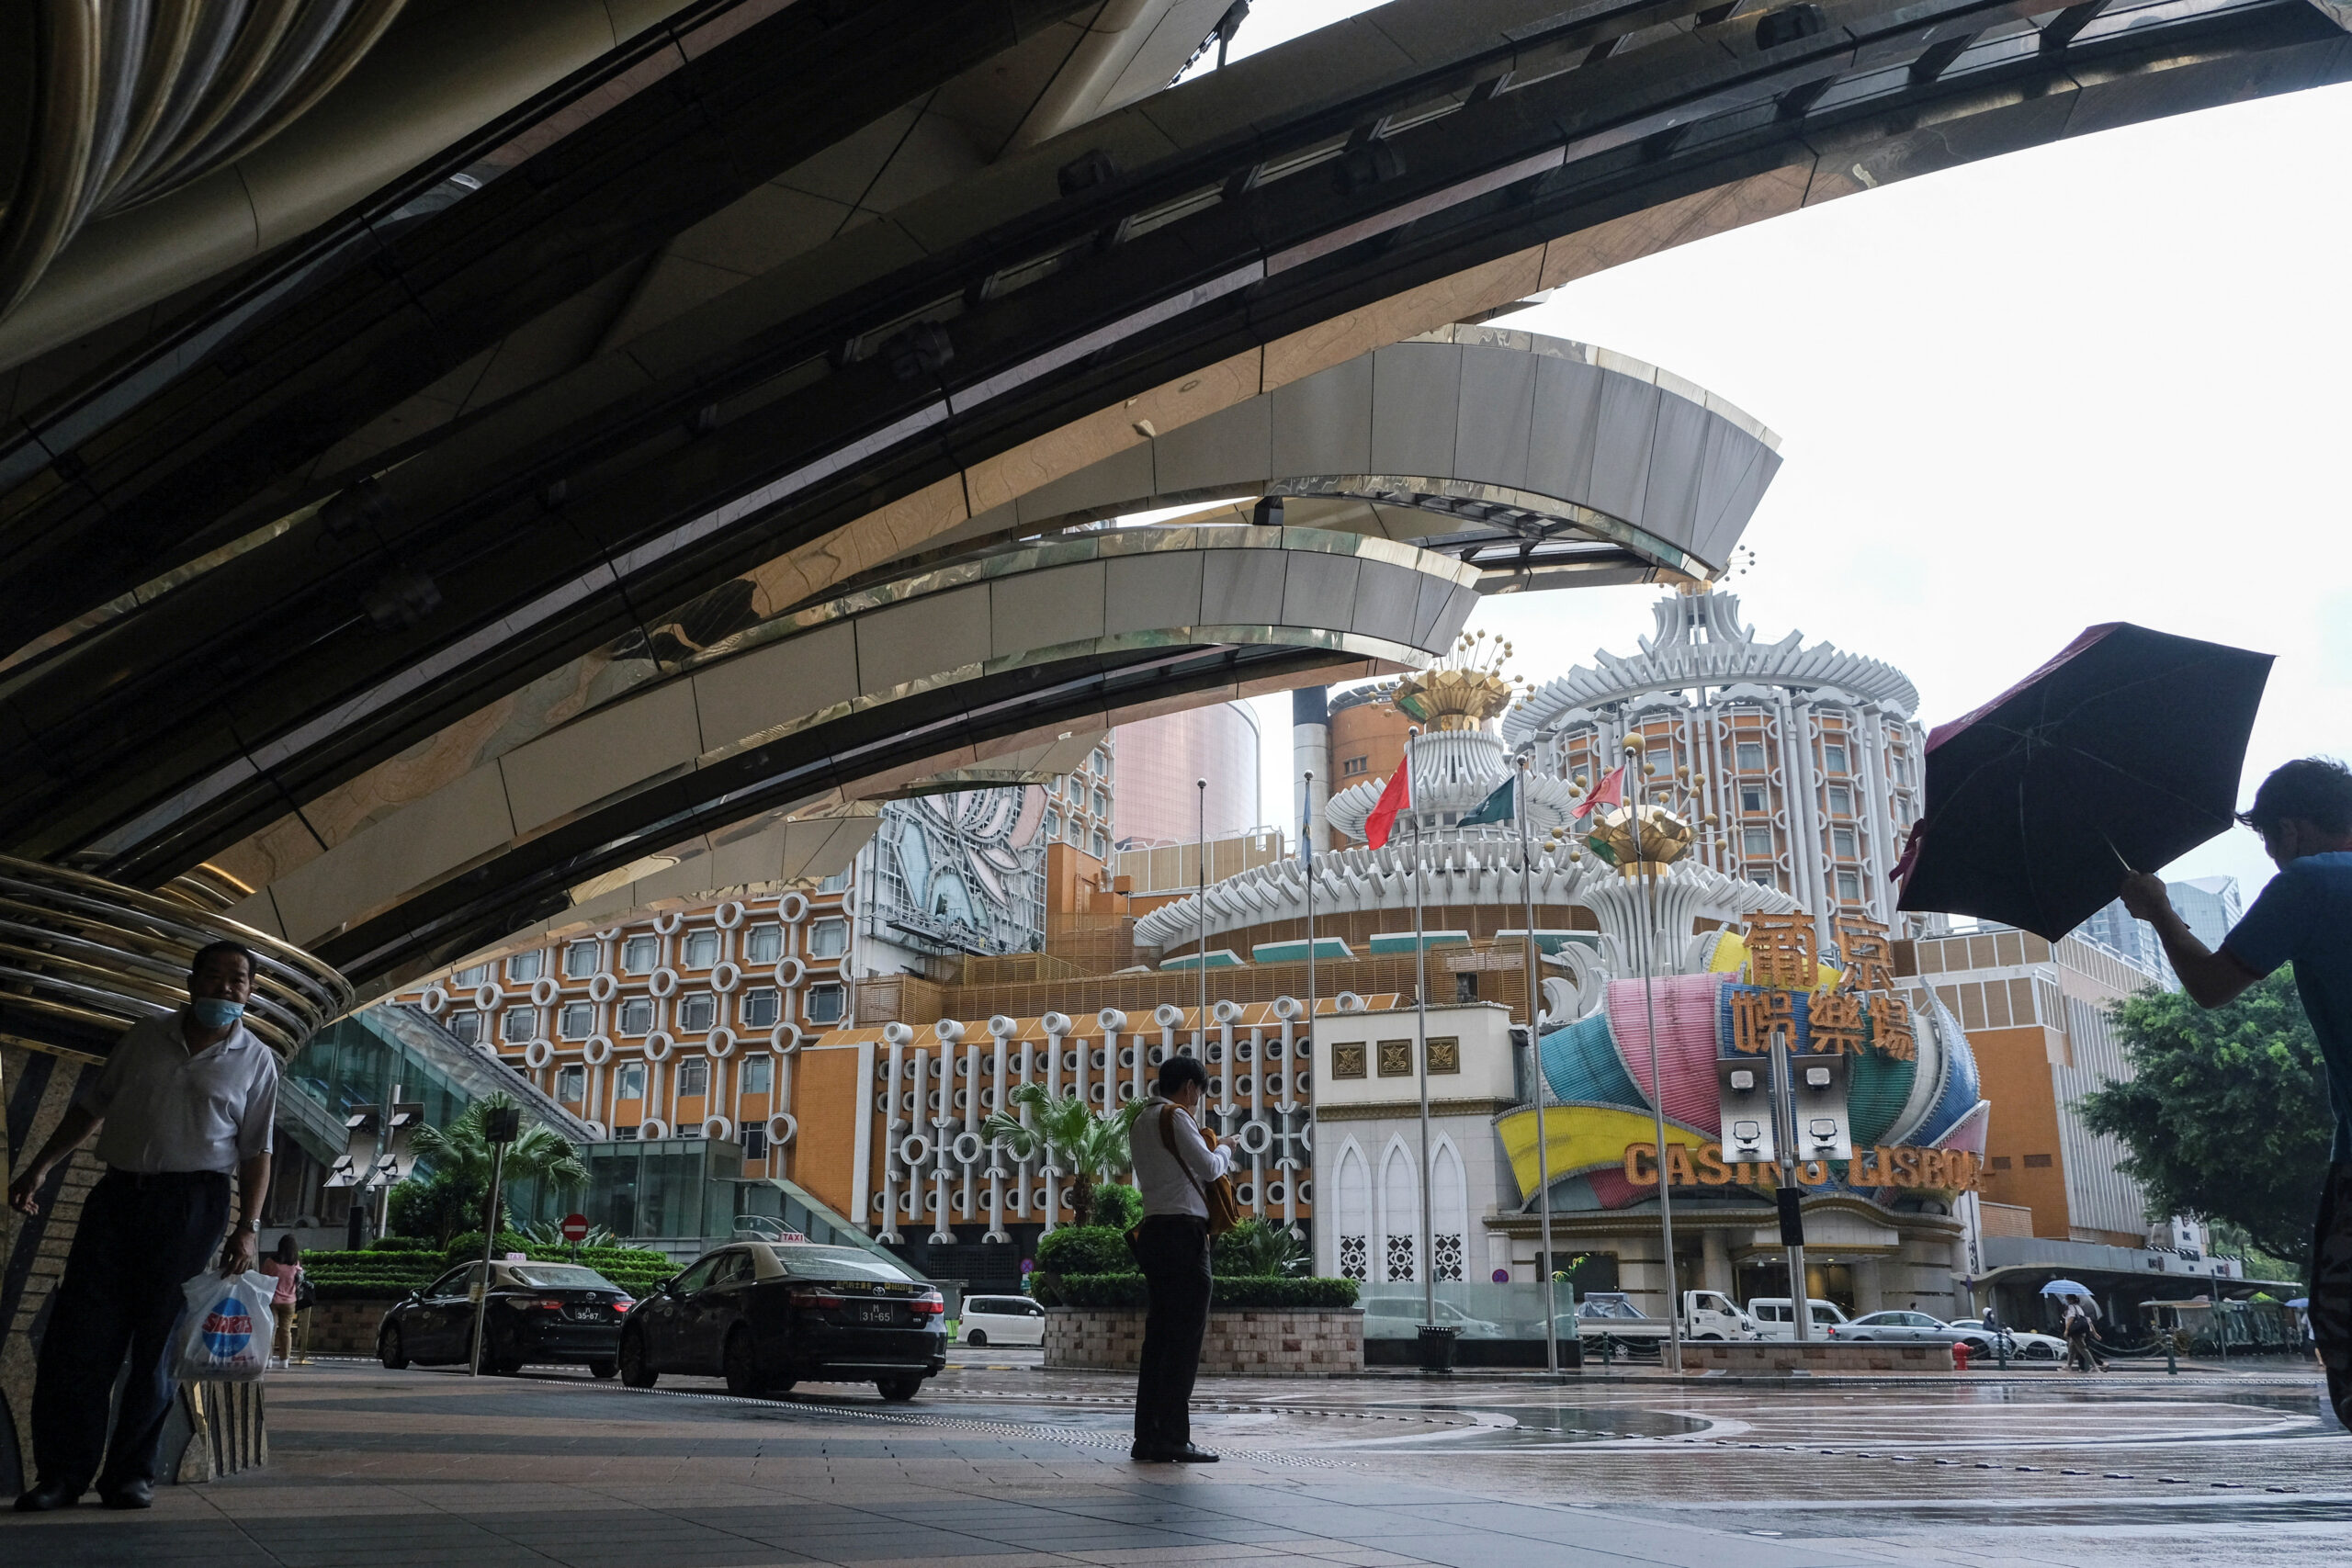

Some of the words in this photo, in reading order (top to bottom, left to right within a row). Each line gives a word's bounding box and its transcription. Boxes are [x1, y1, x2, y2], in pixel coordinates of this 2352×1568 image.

[1742, 908, 1894, 990] 葡京
[1730, 989, 1918, 1062] 娛樂場
[1848, 1145, 1986, 1192] LISBOA
[783, 1234, 803, 1242] TAXI
[873, 1303, 879, 1313] M
[577, 1312, 599, 1320] 35-87
[862, 1312, 890, 1322] 31-65
